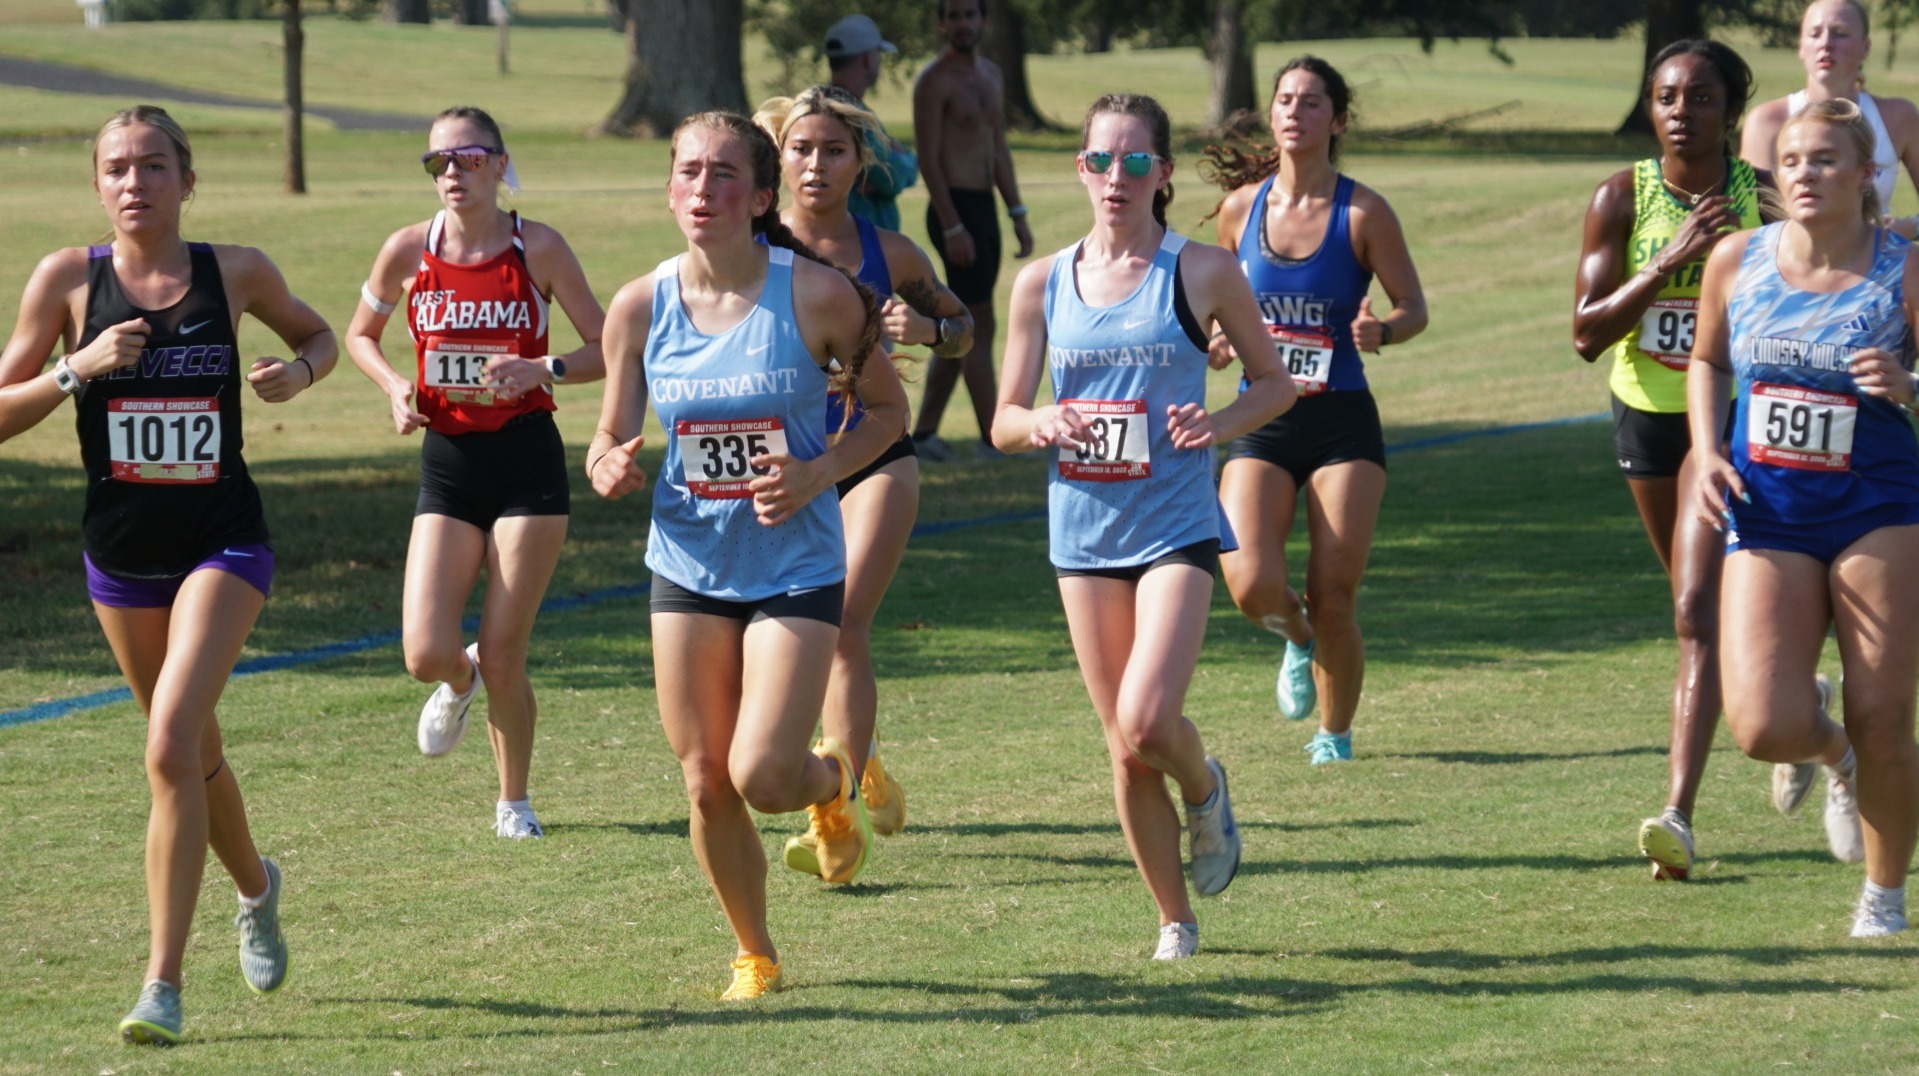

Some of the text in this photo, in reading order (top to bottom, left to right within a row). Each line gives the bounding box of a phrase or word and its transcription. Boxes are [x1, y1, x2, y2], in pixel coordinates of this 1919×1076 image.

[411, 289, 456, 306] WEST
[415, 301, 531, 332] ALABAMA
[1750, 336, 1809, 367] LINDSEY
[651, 367, 798, 404] COVENANT
[121, 400, 211, 411] SOUTHERN SHOWCASE
[1099, 403, 1137, 413] SHOWCASE
[118, 414, 215, 462] 1012
[690, 421, 773, 433] SOUTHERN SHOWCASE
[1766, 401, 1833, 452] 591
[699, 434, 772, 479] 335
[708, 484, 742, 492] SEPTEMBER
